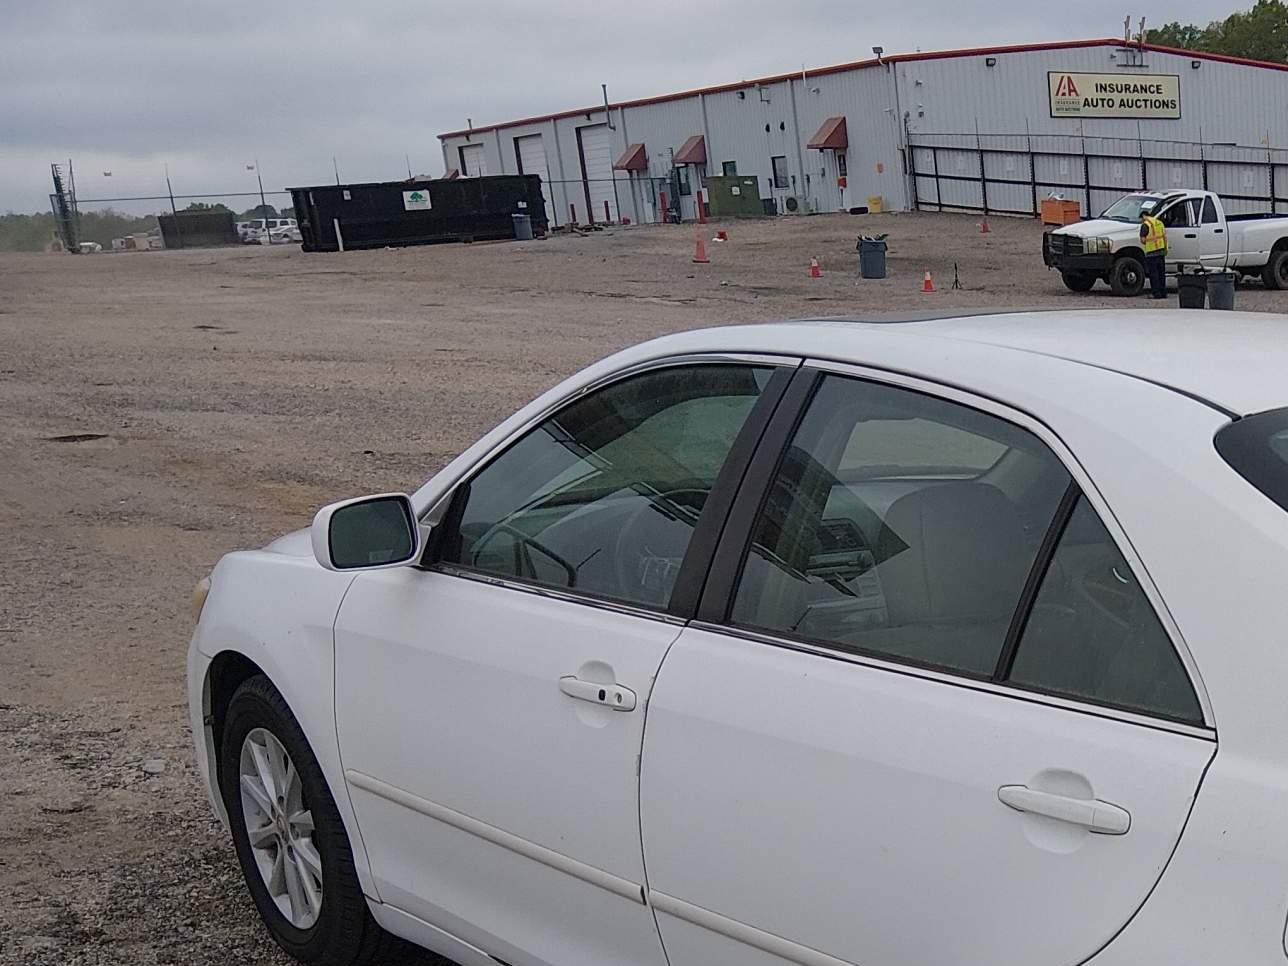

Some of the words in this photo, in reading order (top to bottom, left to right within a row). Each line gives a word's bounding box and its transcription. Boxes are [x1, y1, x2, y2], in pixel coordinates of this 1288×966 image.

[1095, 83, 1163, 95] INSURANCE
[1082, 97, 1115, 108] AUTO
[1118, 98, 1177, 109] AUCTIONS
